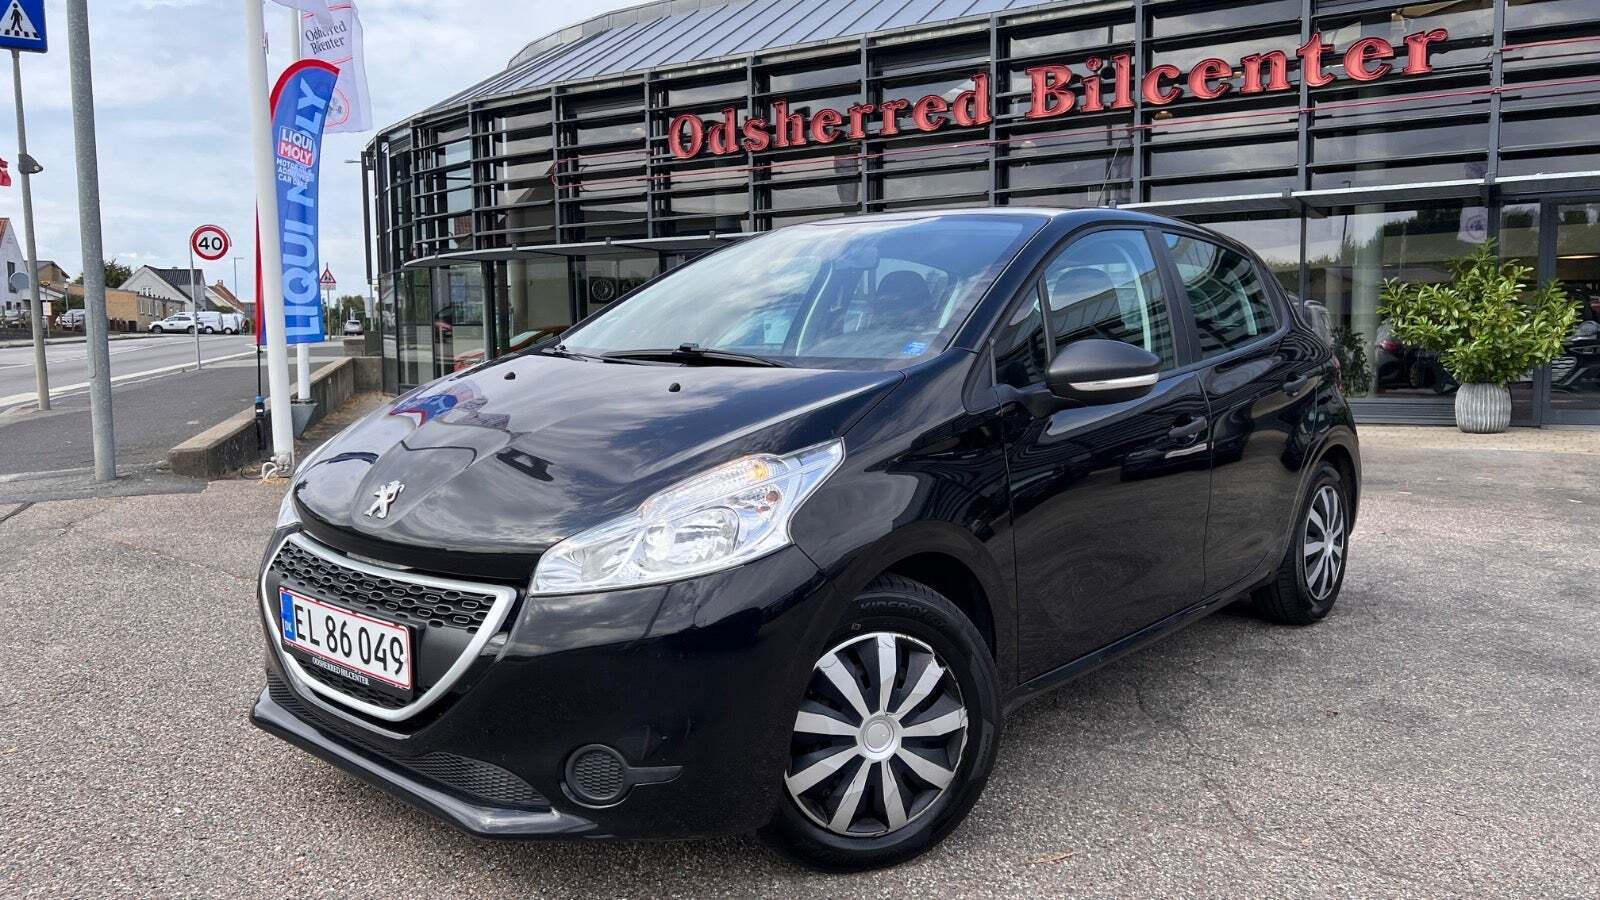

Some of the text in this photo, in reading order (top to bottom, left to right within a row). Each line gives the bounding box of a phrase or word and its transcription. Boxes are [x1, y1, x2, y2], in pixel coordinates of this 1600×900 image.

[305, 20, 347, 42] Odhred
[667, 27, 1450, 160] Odsherred Bilcenter
[282, 128, 313, 152] LIQUI
[280, 141, 312, 165] MOLY
[278, 172, 292, 184] CAR
[198, 237, 223, 250] 40
[282, 219, 321, 337] LIQUI
[294, 604, 404, 675] EL 86 049
